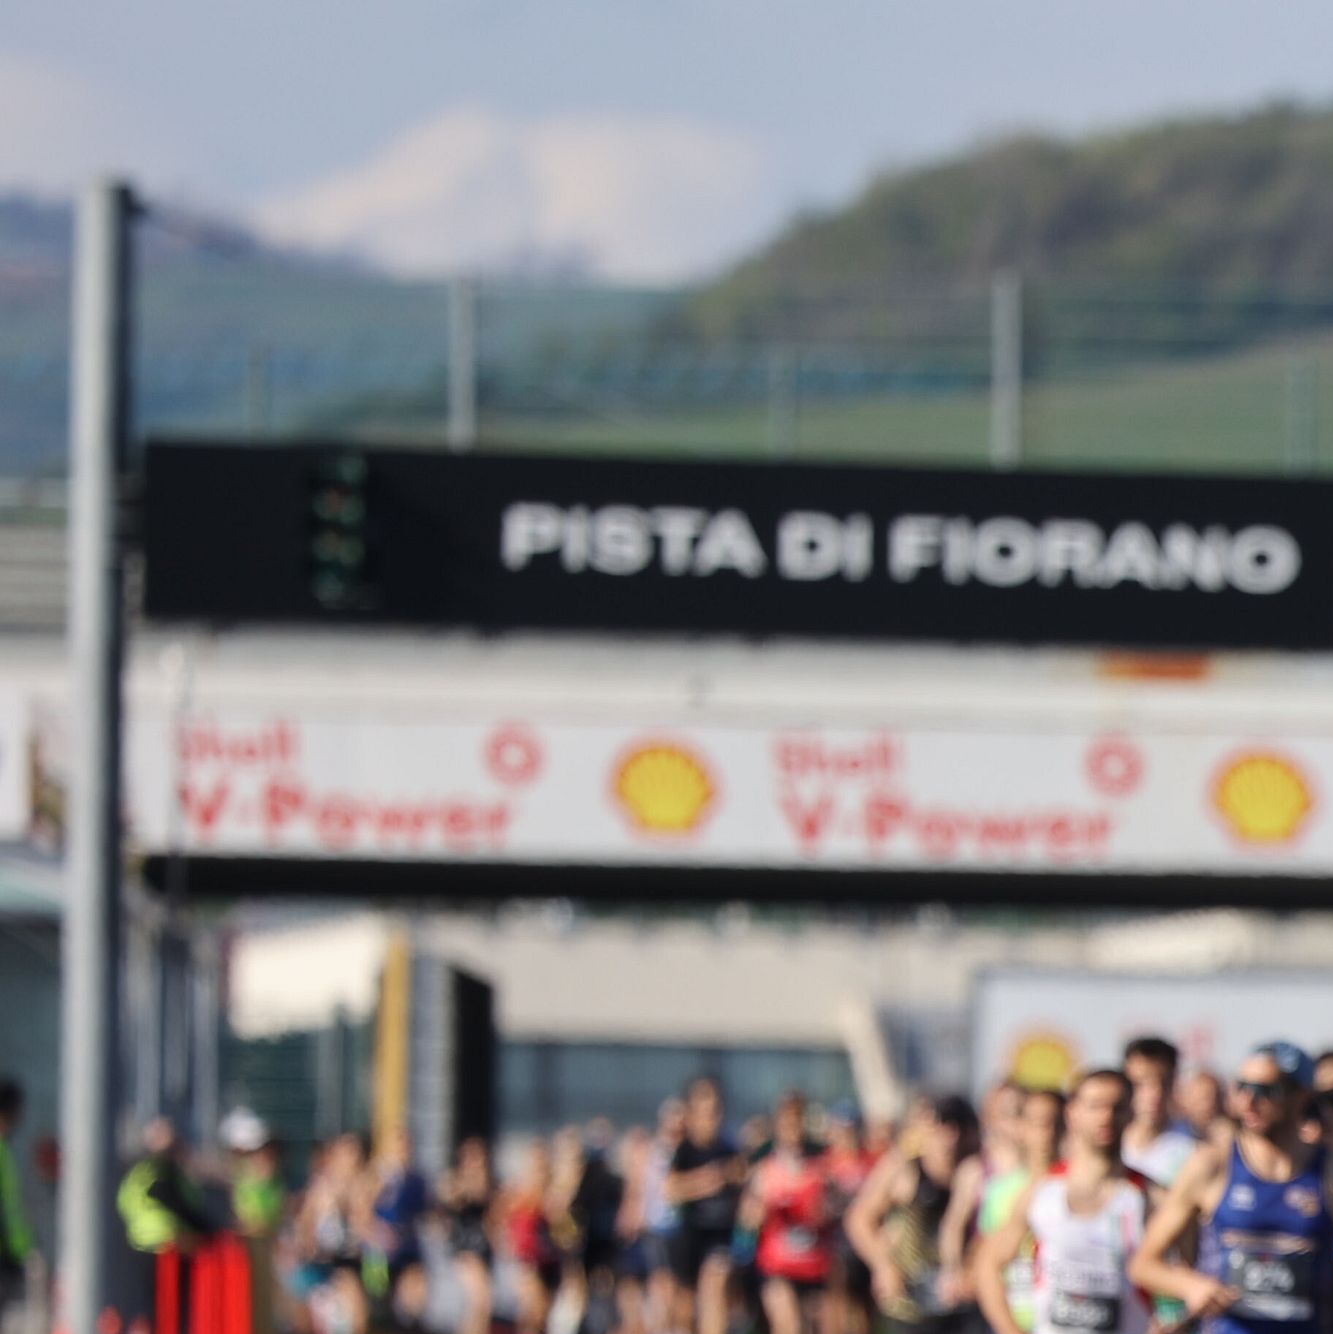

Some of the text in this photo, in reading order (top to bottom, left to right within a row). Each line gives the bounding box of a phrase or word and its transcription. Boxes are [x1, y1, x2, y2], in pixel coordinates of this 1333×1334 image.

[501, 502, 1302, 595] PISTA DI FIORANO
